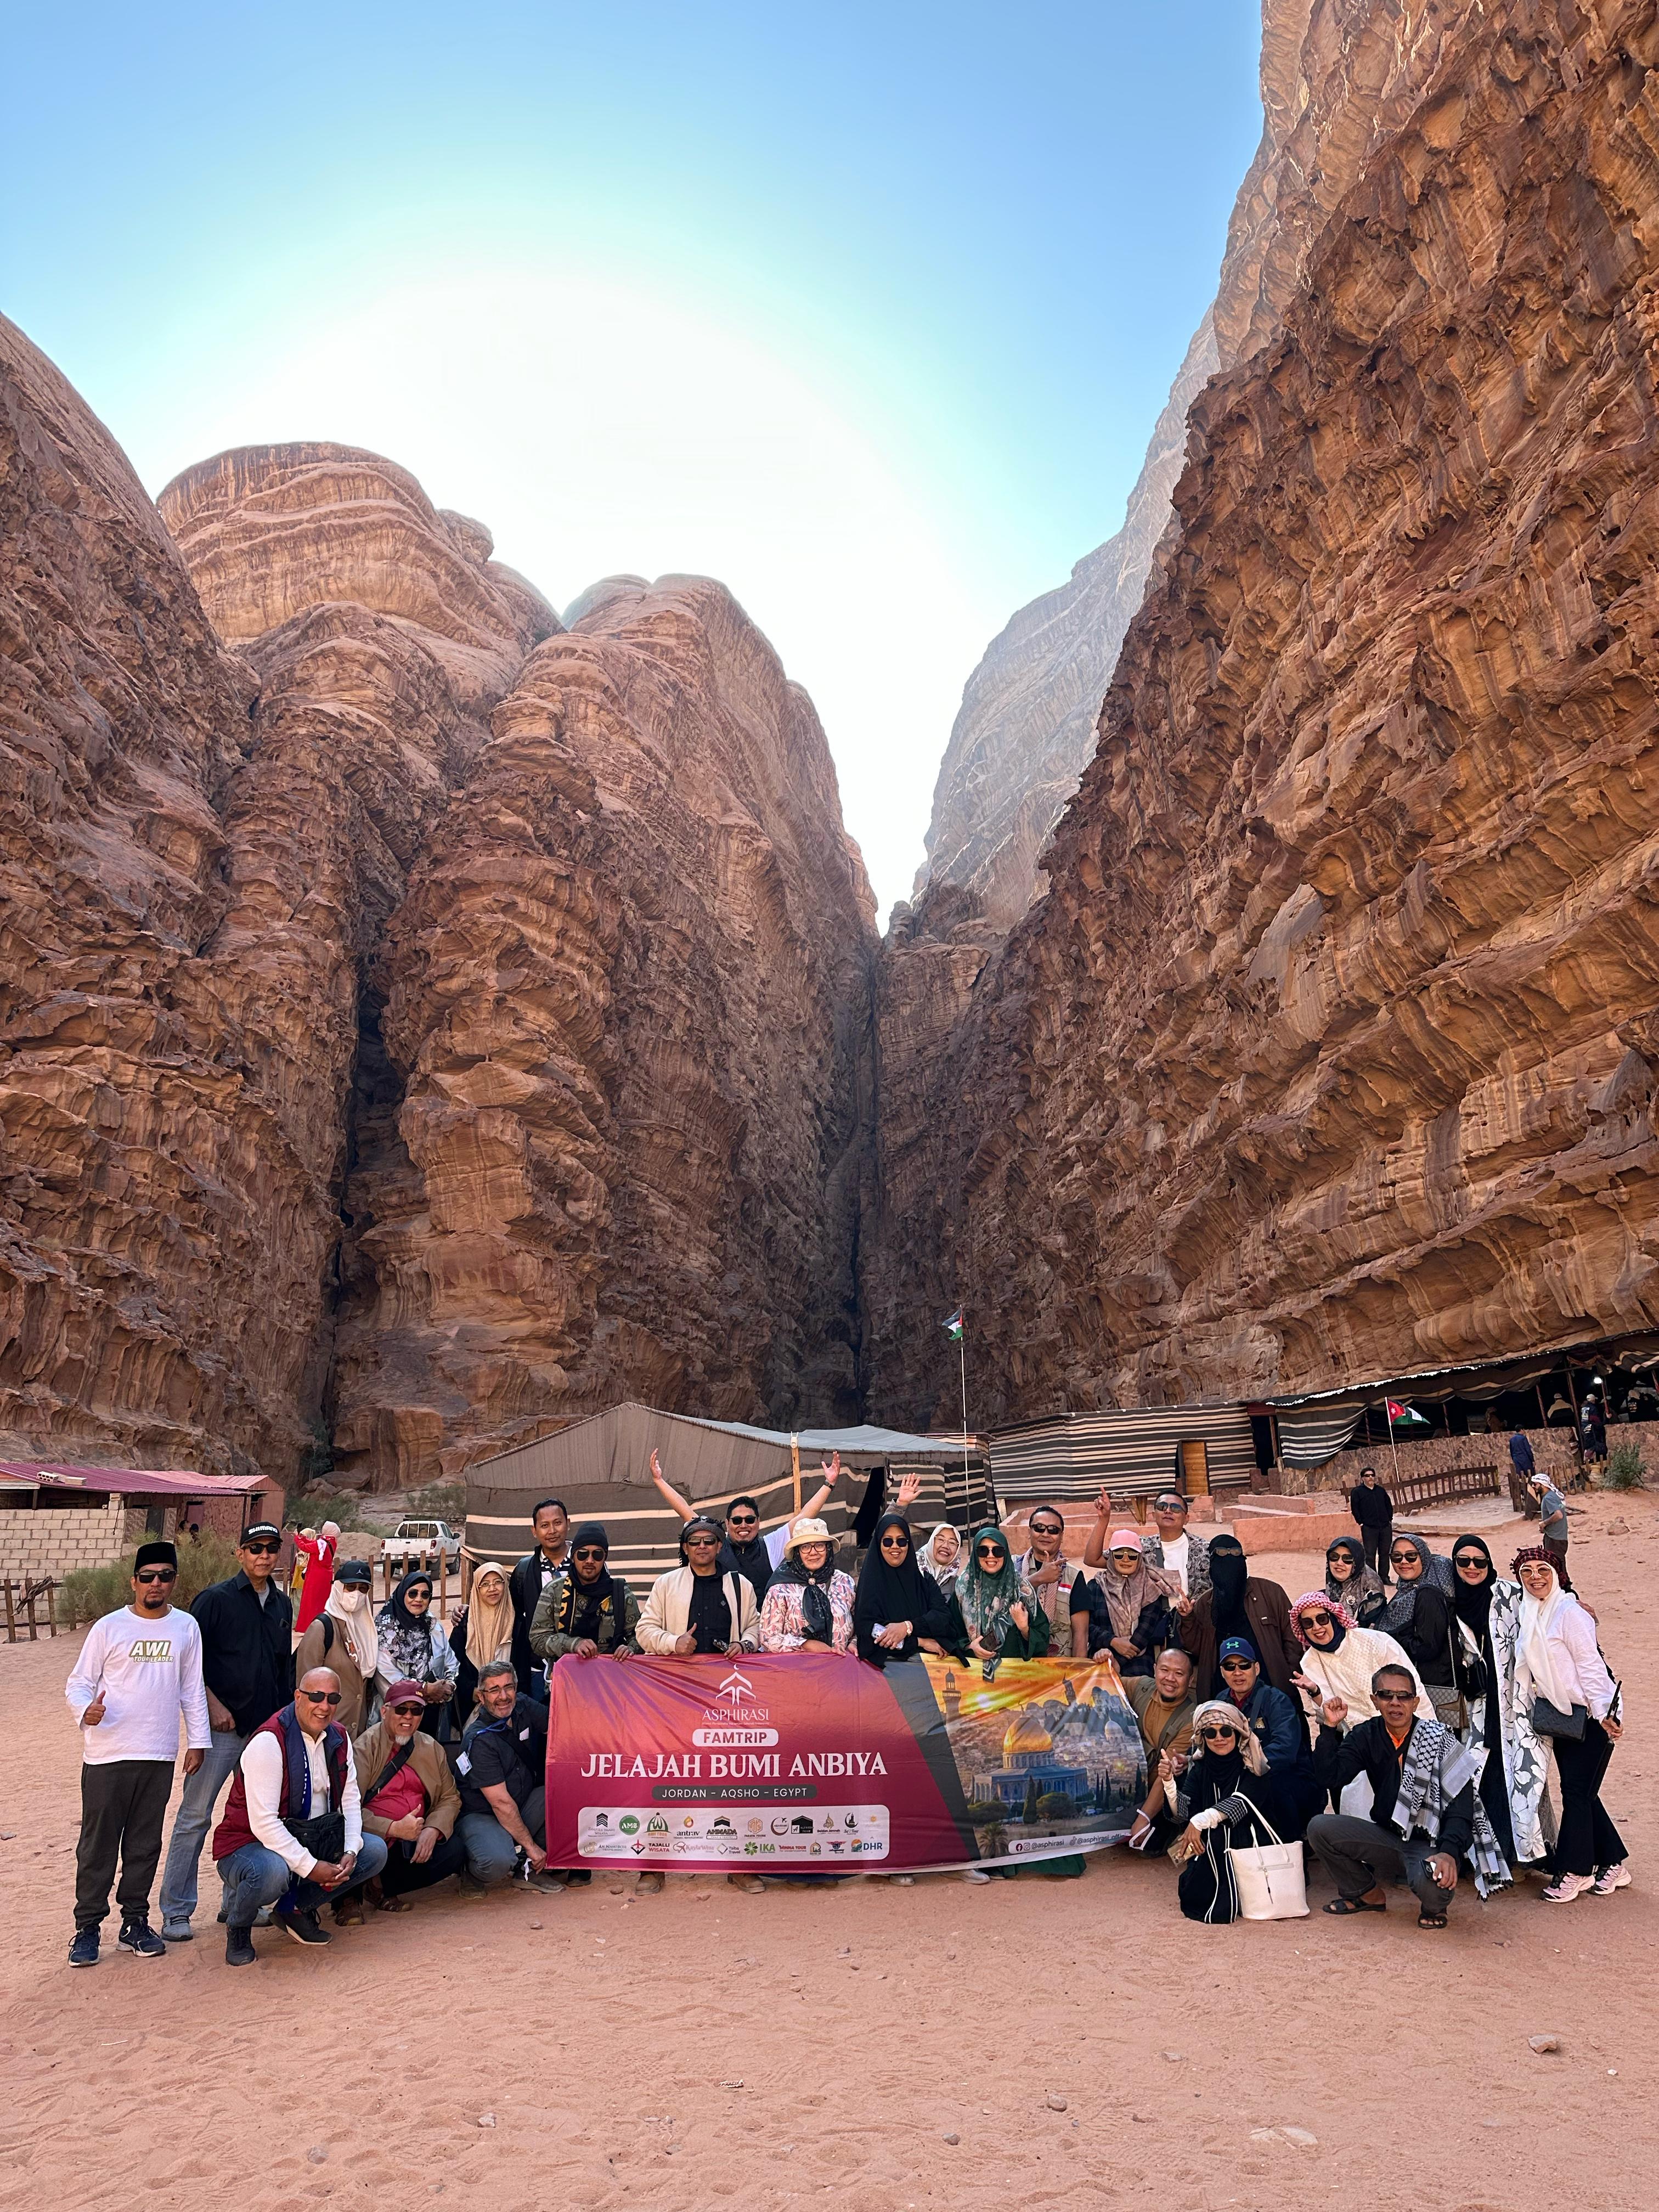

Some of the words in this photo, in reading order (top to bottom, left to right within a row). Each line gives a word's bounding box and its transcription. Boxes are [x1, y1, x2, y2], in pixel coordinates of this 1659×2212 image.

[131, 1641, 170, 1656] AWI
[702, 1708, 769, 1720] ASPHIRASI
[703, 1732, 767, 1743] FAMTRIP
[580, 1753, 702, 1778] JELAJAH
[709, 1754, 781, 1778] BUMI
[788, 1752, 888, 1776] ANBIYA
[662, 1789, 707, 1798] JORDAN
[721, 1788, 759, 1798] AQSHO
[774, 1788, 807, 1797] EGYPT
[760, 1843, 775, 1852] IKA
[1031, 1839, 1064, 1850] @asphirasi
